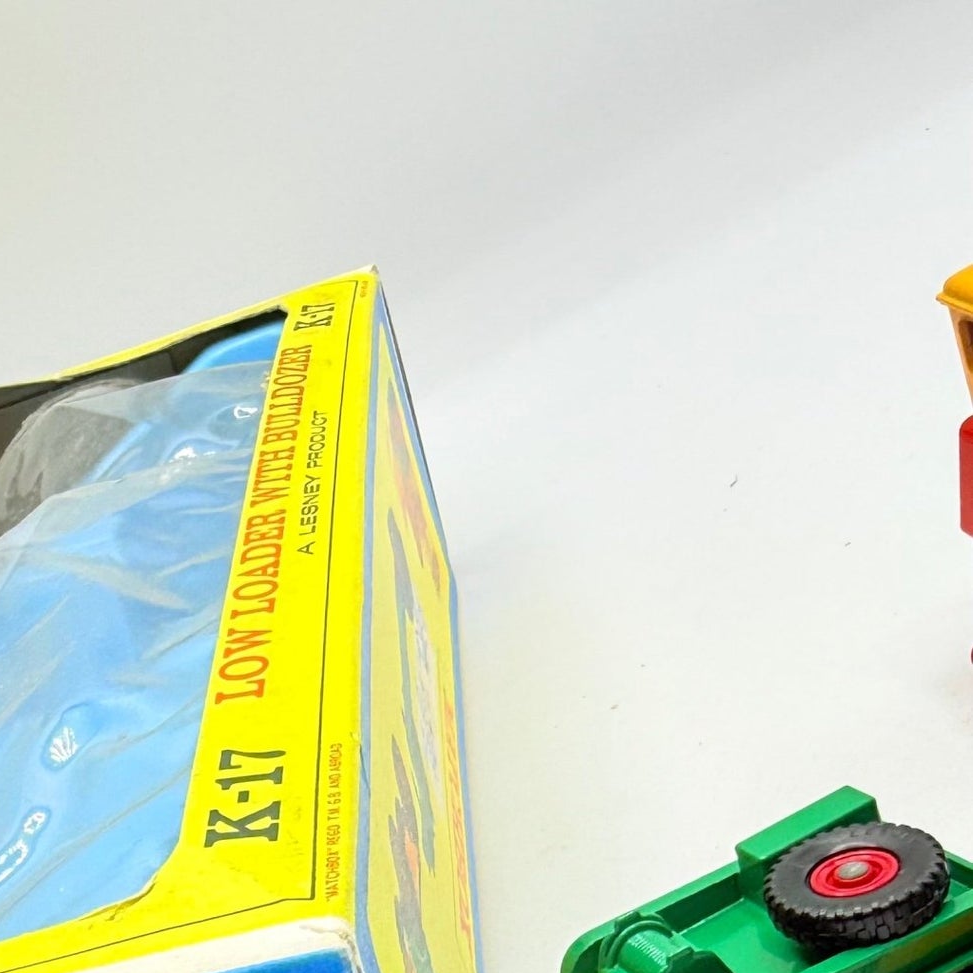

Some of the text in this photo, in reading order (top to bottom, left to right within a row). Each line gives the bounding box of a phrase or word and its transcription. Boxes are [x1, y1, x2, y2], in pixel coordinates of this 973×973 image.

[292, 302, 336, 332] K-17
[214, 344, 313, 705] LOW LOADER WITH BULLDOZER
[297, 410, 328, 556] A LESNEY PRODUCT
[203, 749, 287, 849] K-17
